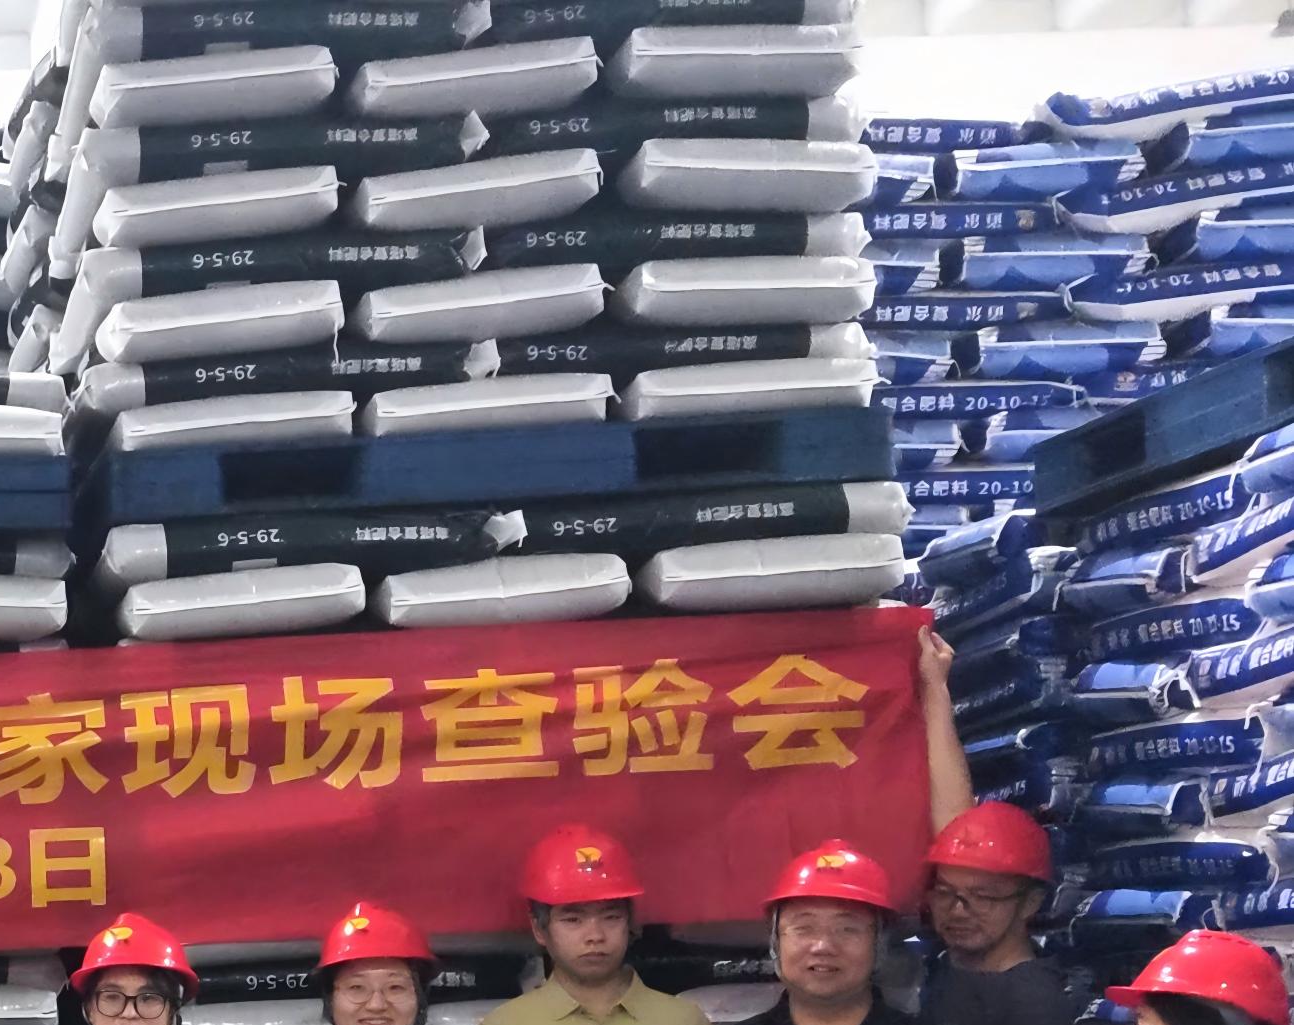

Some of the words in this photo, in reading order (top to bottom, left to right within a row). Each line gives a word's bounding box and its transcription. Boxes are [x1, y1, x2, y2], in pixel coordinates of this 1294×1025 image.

[192, 12, 256, 28] 29-5-6
[524, 4, 586, 22] 29-5-6
[528, 116, 592, 134] 29-5-6
[190, 130, 252, 148] 29-5-6
[526, 230, 588, 248] 29-5-6
[192, 250, 254, 268] 29-5-6
[526, 344, 588, 362] 29-5-6
[194, 364, 256, 382] 29-5-6
[552, 516, 618, 536] 29-5-6
[218, 528, 280, 546] 29-5-6
[246, 970, 310, 990] 29-5-6
